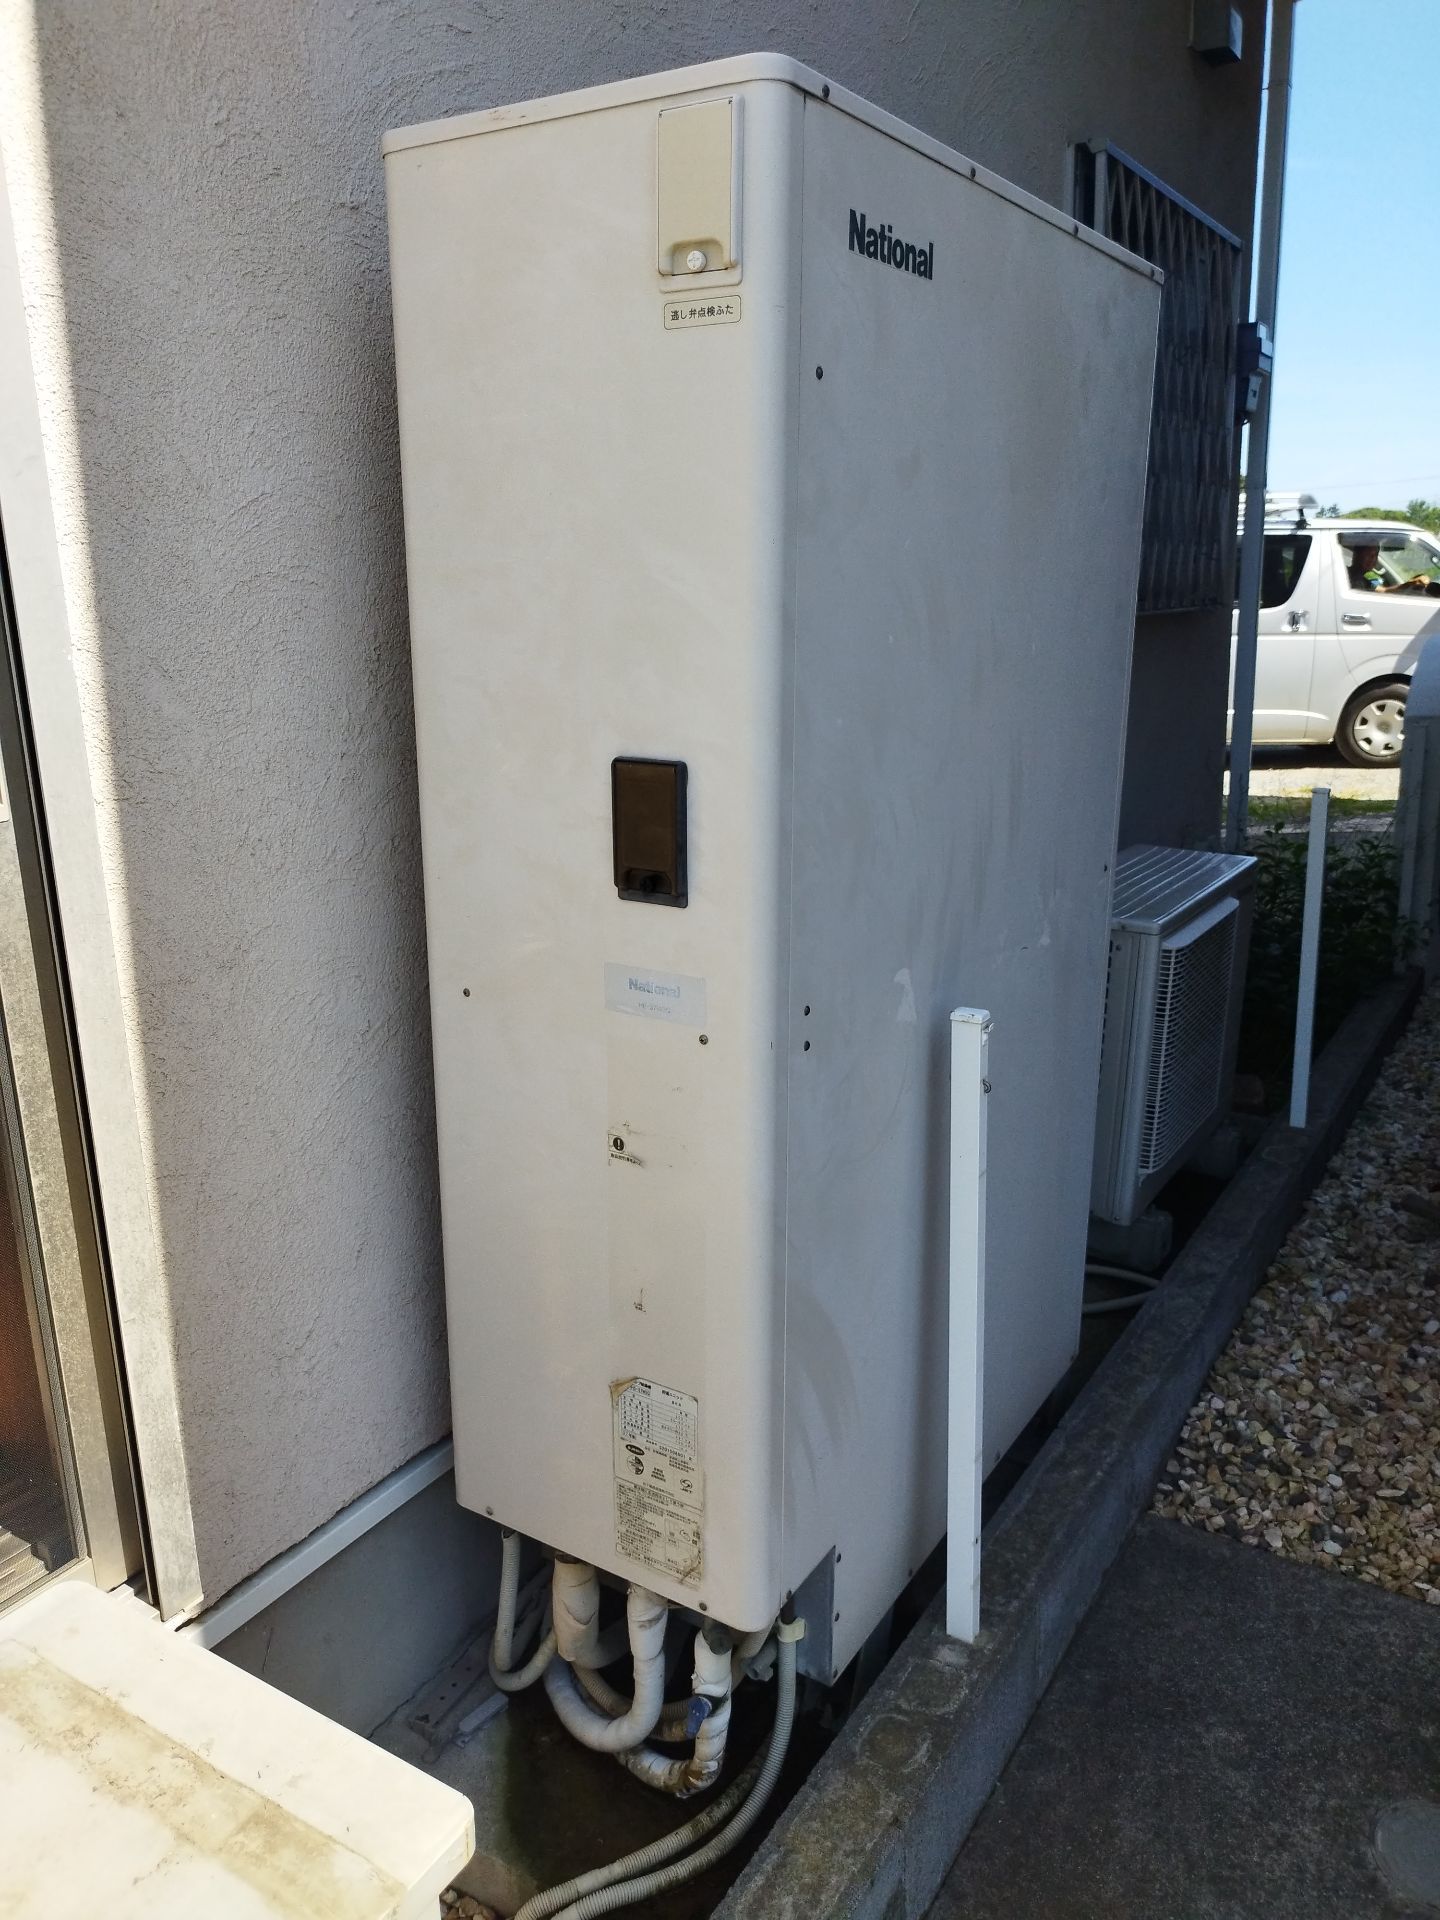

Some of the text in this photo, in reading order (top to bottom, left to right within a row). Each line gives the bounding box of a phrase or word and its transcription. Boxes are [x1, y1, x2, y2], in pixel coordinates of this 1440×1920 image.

[849, 208, 934, 281] National
[670, 304, 734, 321] 逃し弁点検ふた
